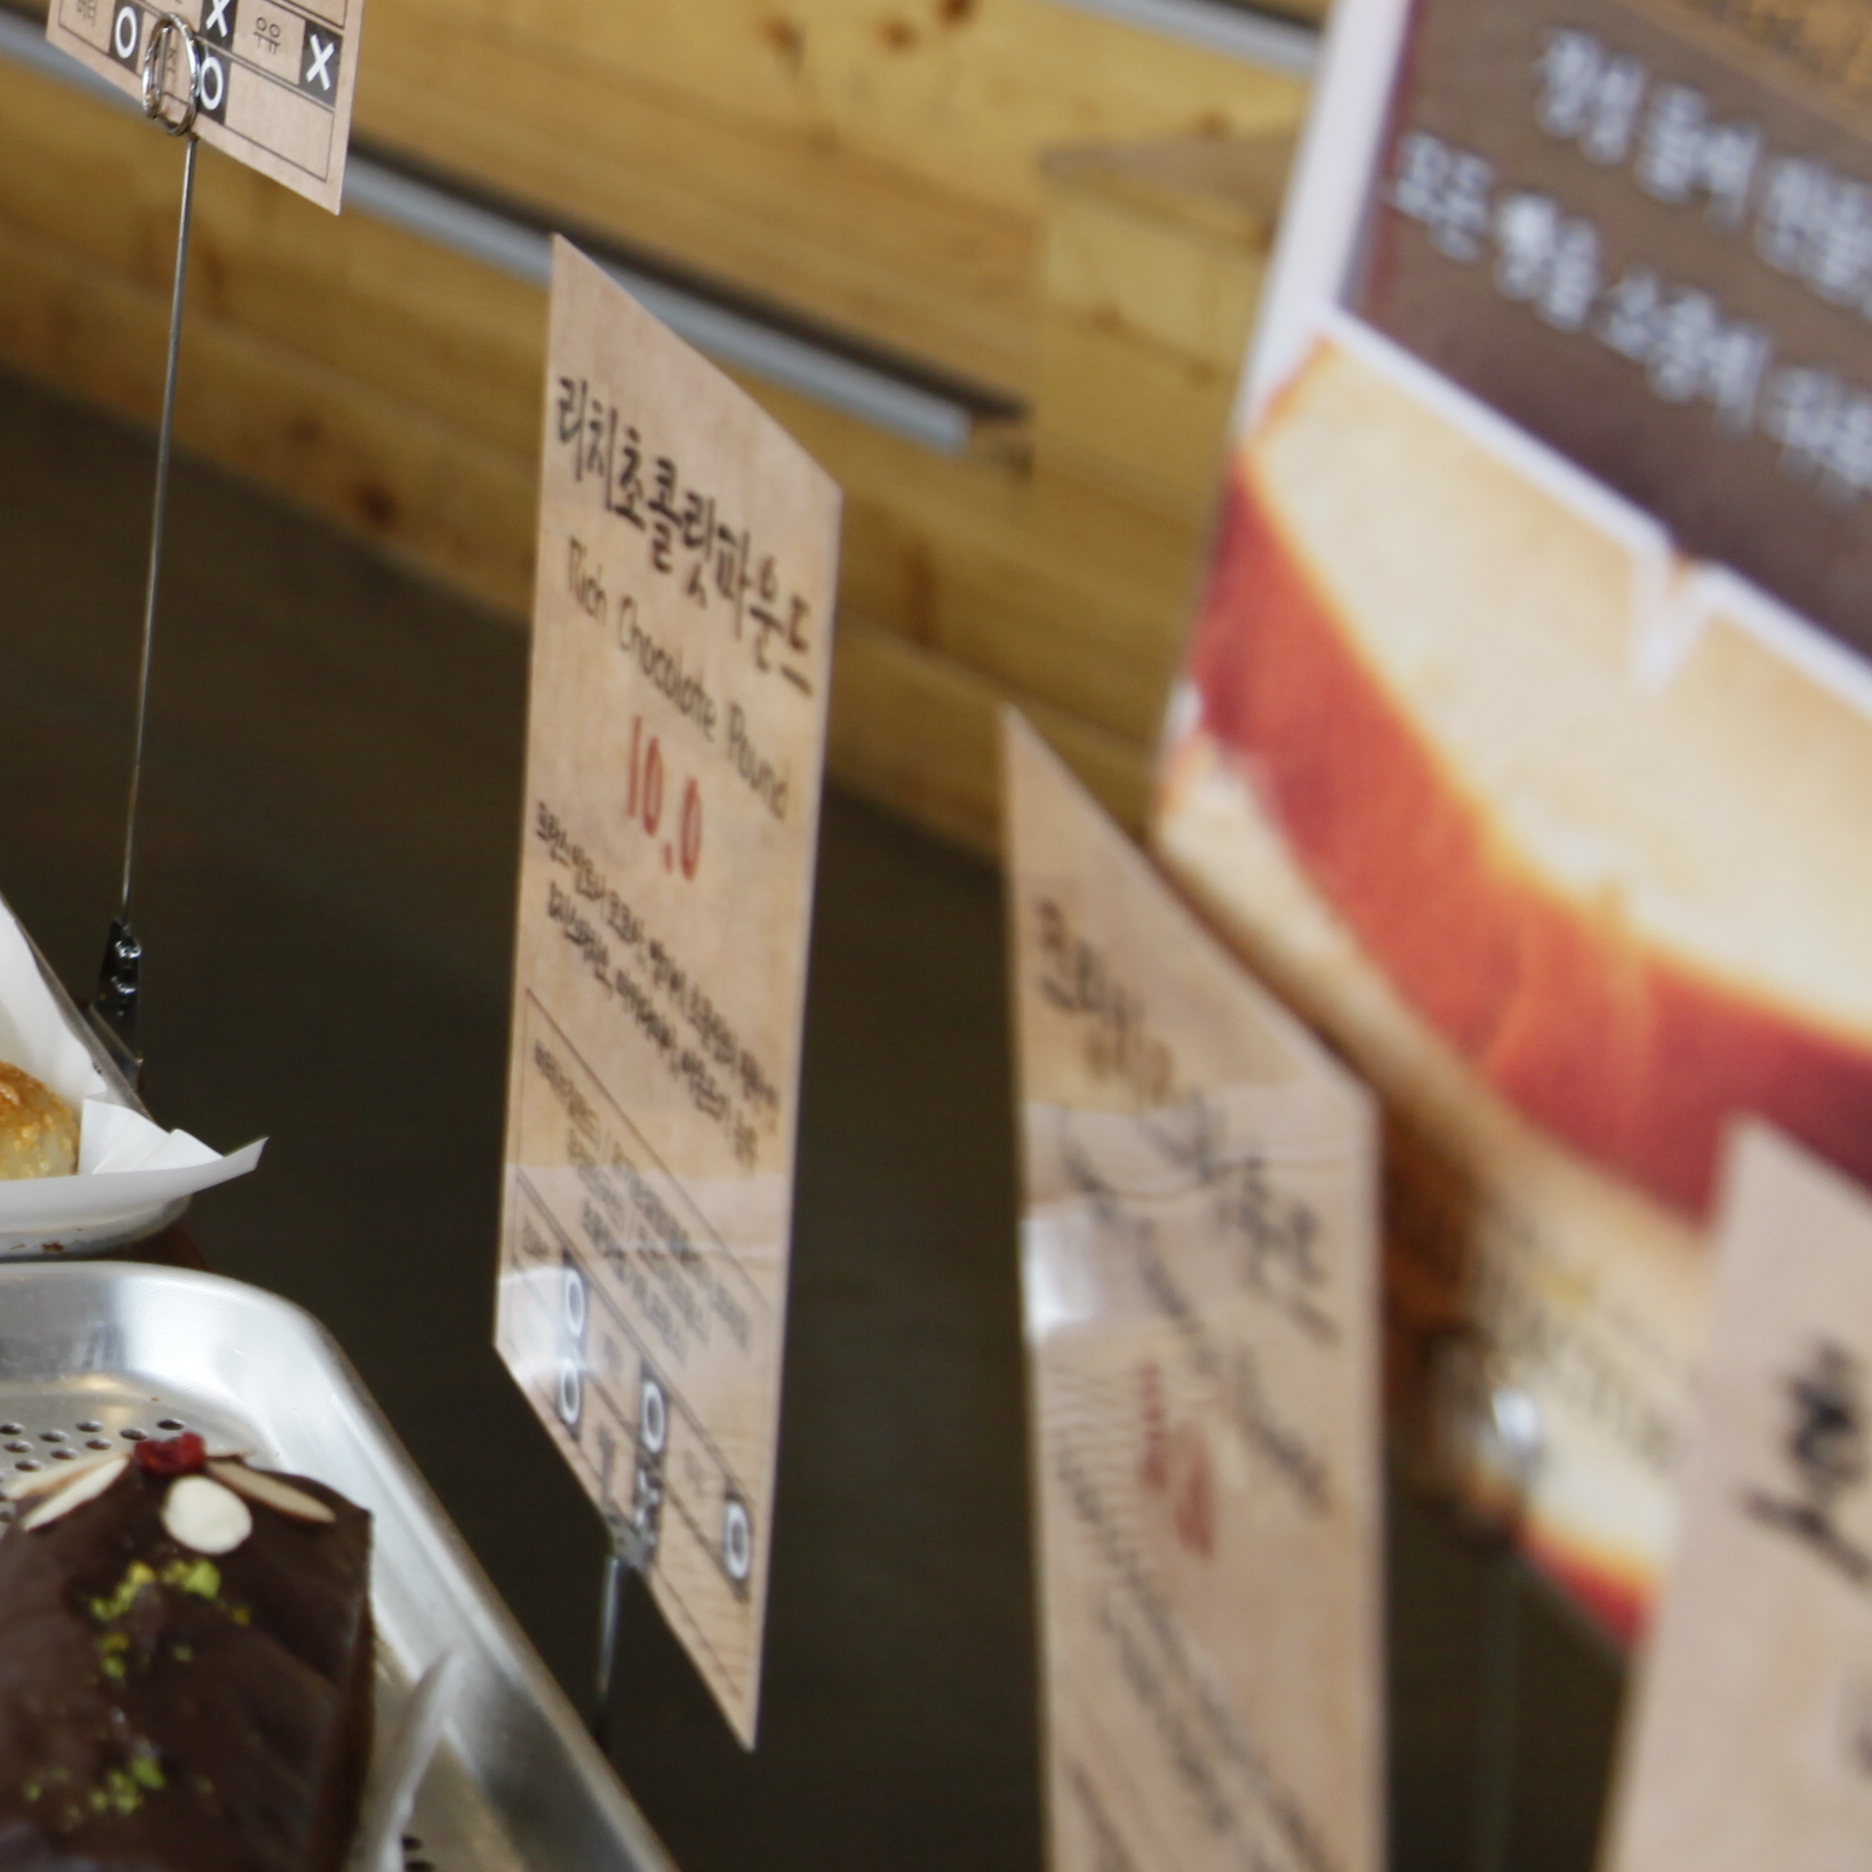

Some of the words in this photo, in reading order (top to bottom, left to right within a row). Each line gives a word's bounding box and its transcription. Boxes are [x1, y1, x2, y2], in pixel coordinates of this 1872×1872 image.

[114, 6, 138, 59] O
[253, 16, 281, 56] 우유
[200, 56, 224, 111] O
[306, 34, 335, 91] X
[557, 377, 812, 698] 리치초콜릿파운드
[567, 537, 607, 628] Rich
[618, 593, 716, 743] Chocolate
[726, 700, 788, 822] Pound
[626, 715, 702, 882] 10.0
